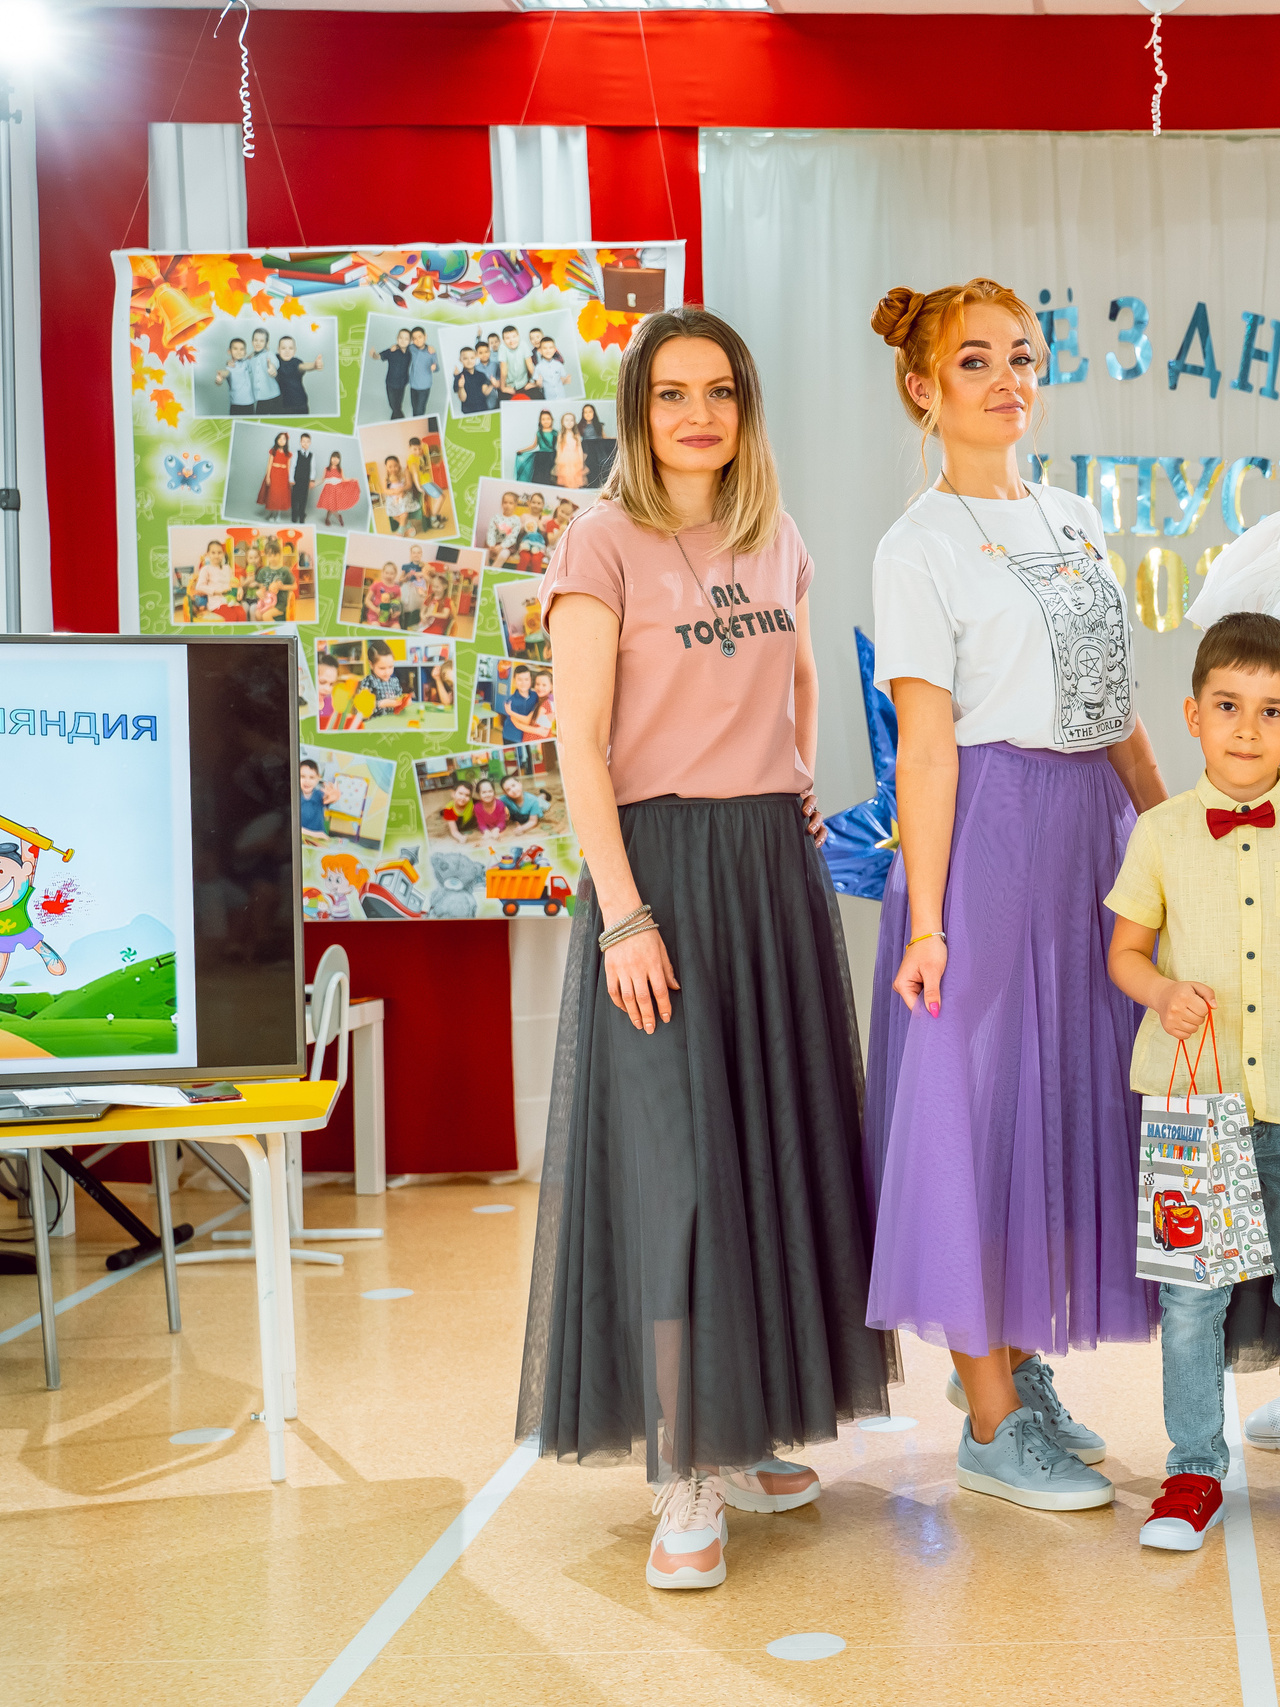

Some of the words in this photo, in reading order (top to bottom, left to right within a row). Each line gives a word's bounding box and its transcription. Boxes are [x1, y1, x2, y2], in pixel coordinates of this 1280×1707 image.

[711, 583, 750, 608] ALL
[1074, 727, 1093, 737] THE
[1147, 1122, 1204, 1143] НАСТОЯЩЕМУ
